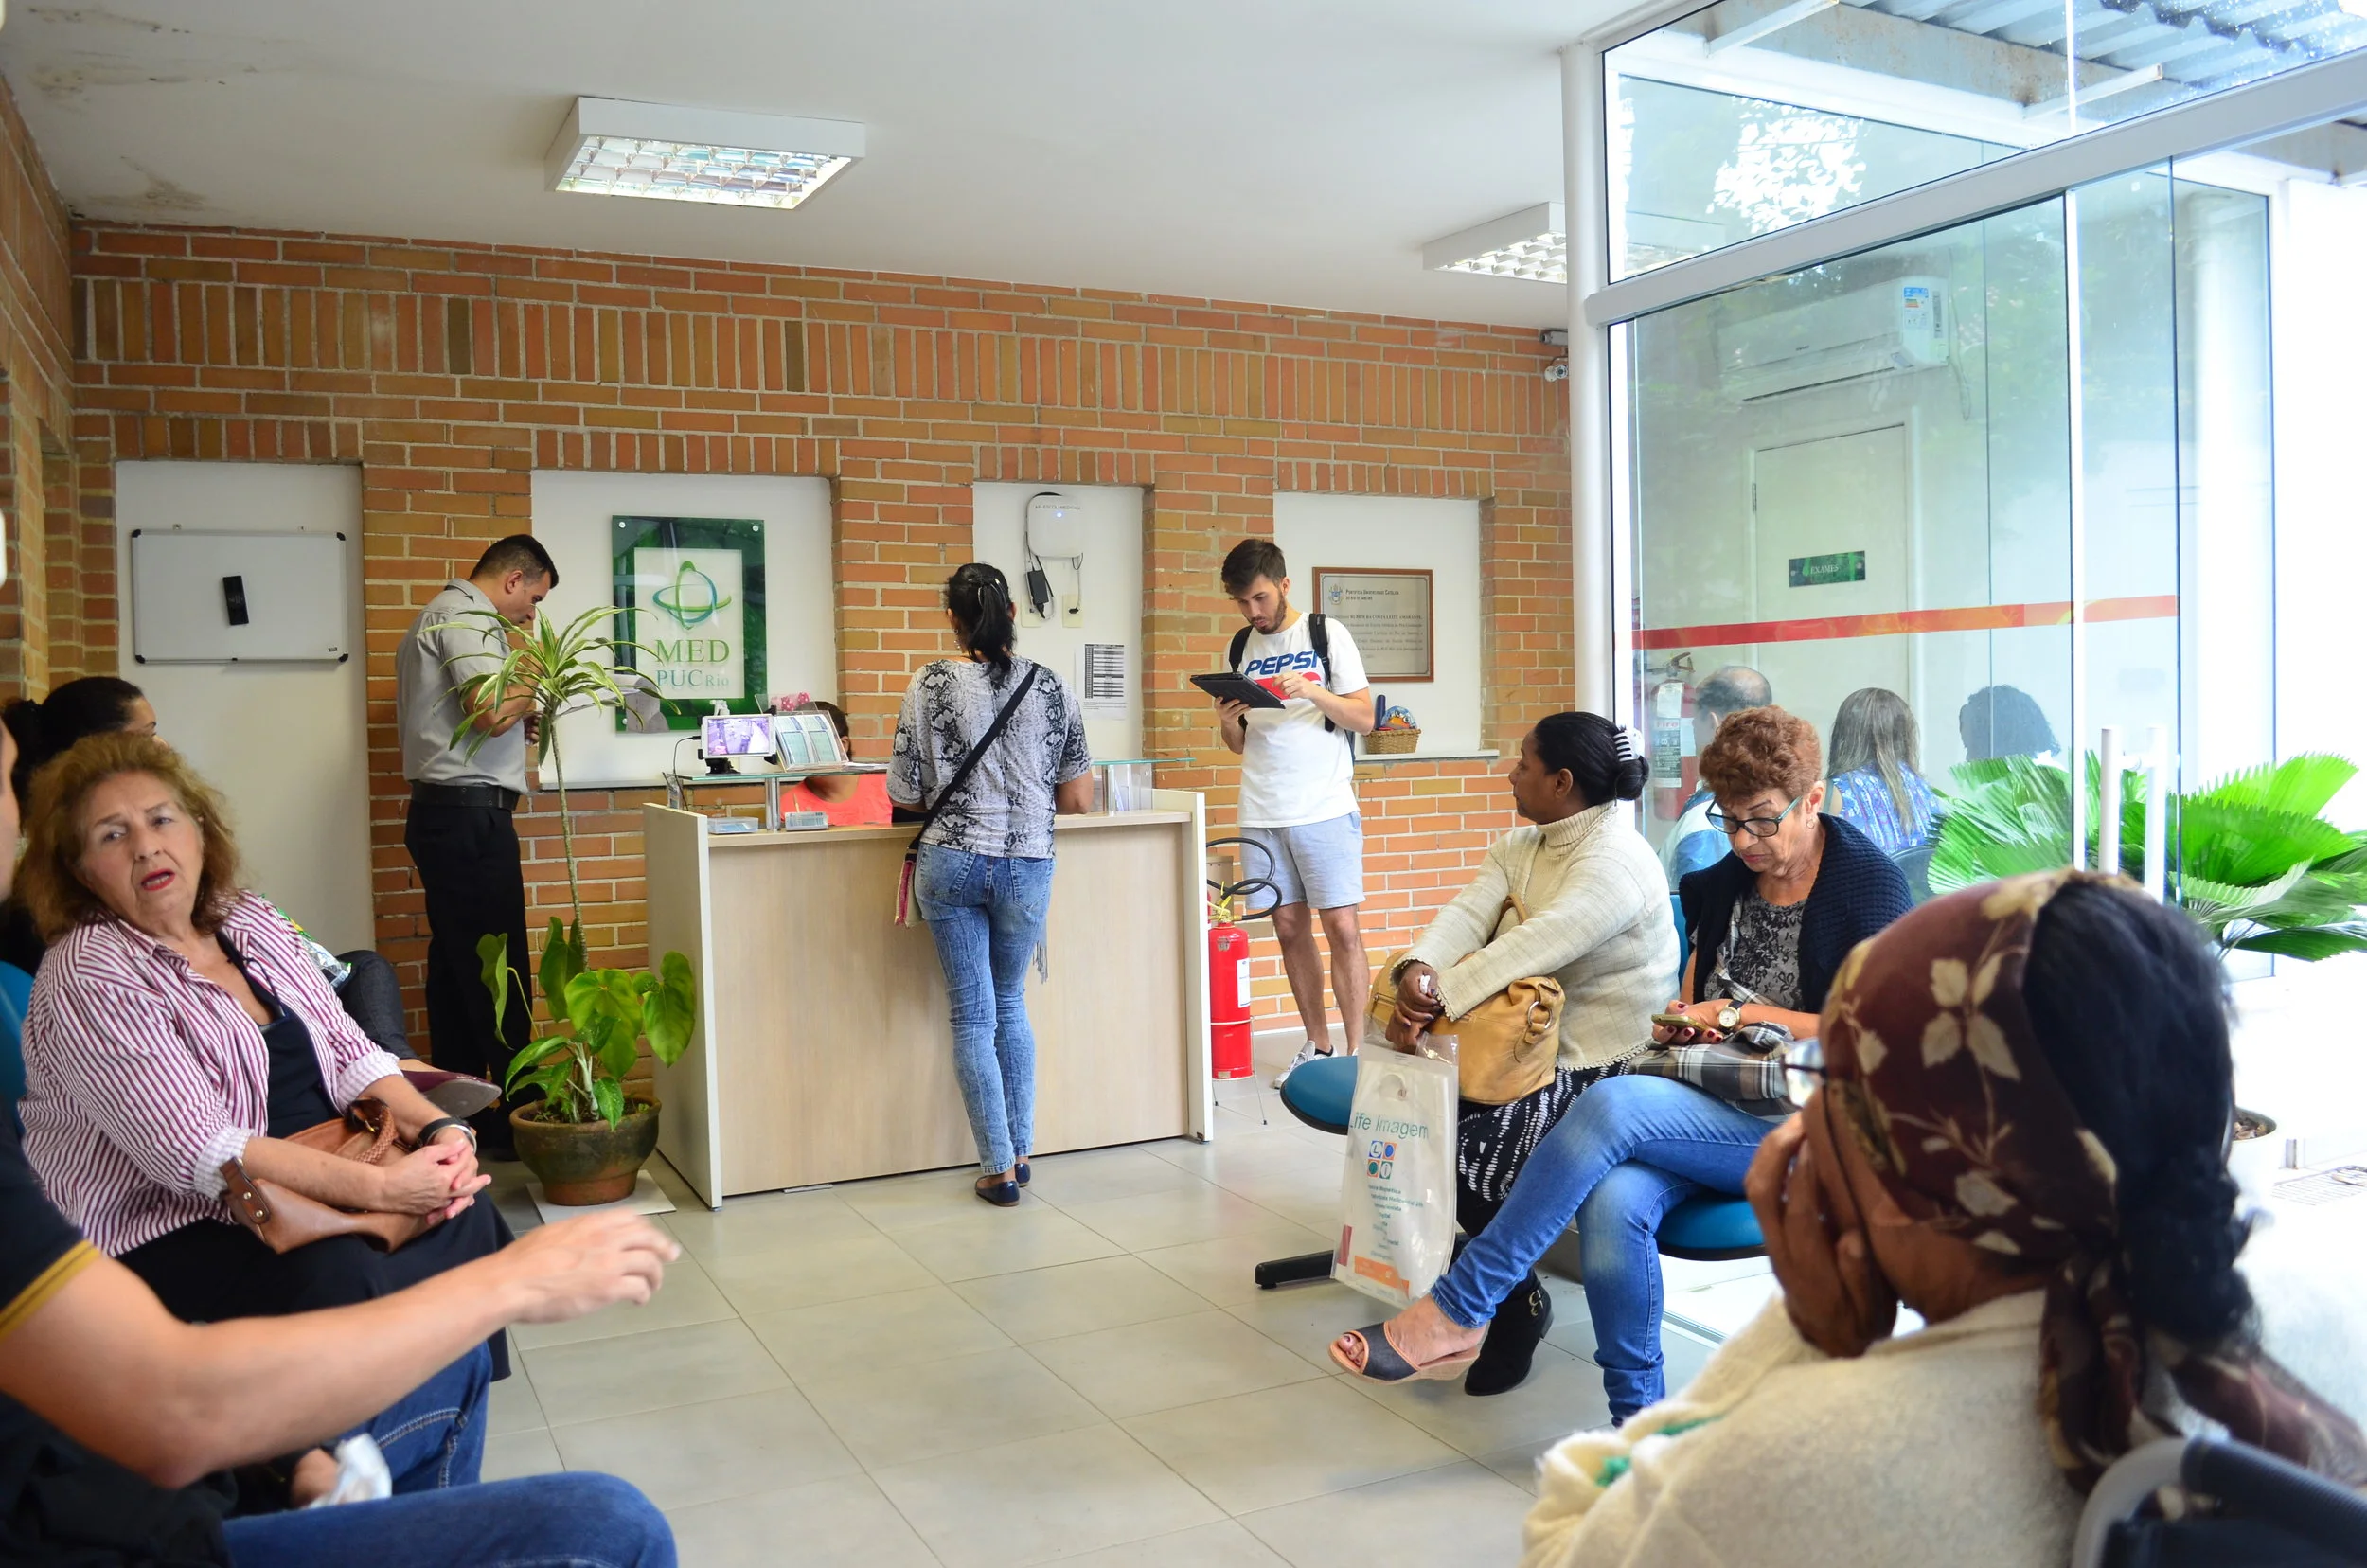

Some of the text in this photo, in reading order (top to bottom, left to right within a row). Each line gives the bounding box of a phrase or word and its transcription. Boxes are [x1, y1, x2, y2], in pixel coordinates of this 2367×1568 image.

[1810, 564, 1840, 575] EXAMES
[654, 639, 730, 663] MED
[1244, 650, 1317, 676] PEPSI
[656, 669, 729, 686] PUC Rio
[1350, 1113, 1429, 1139] ife Imagem
